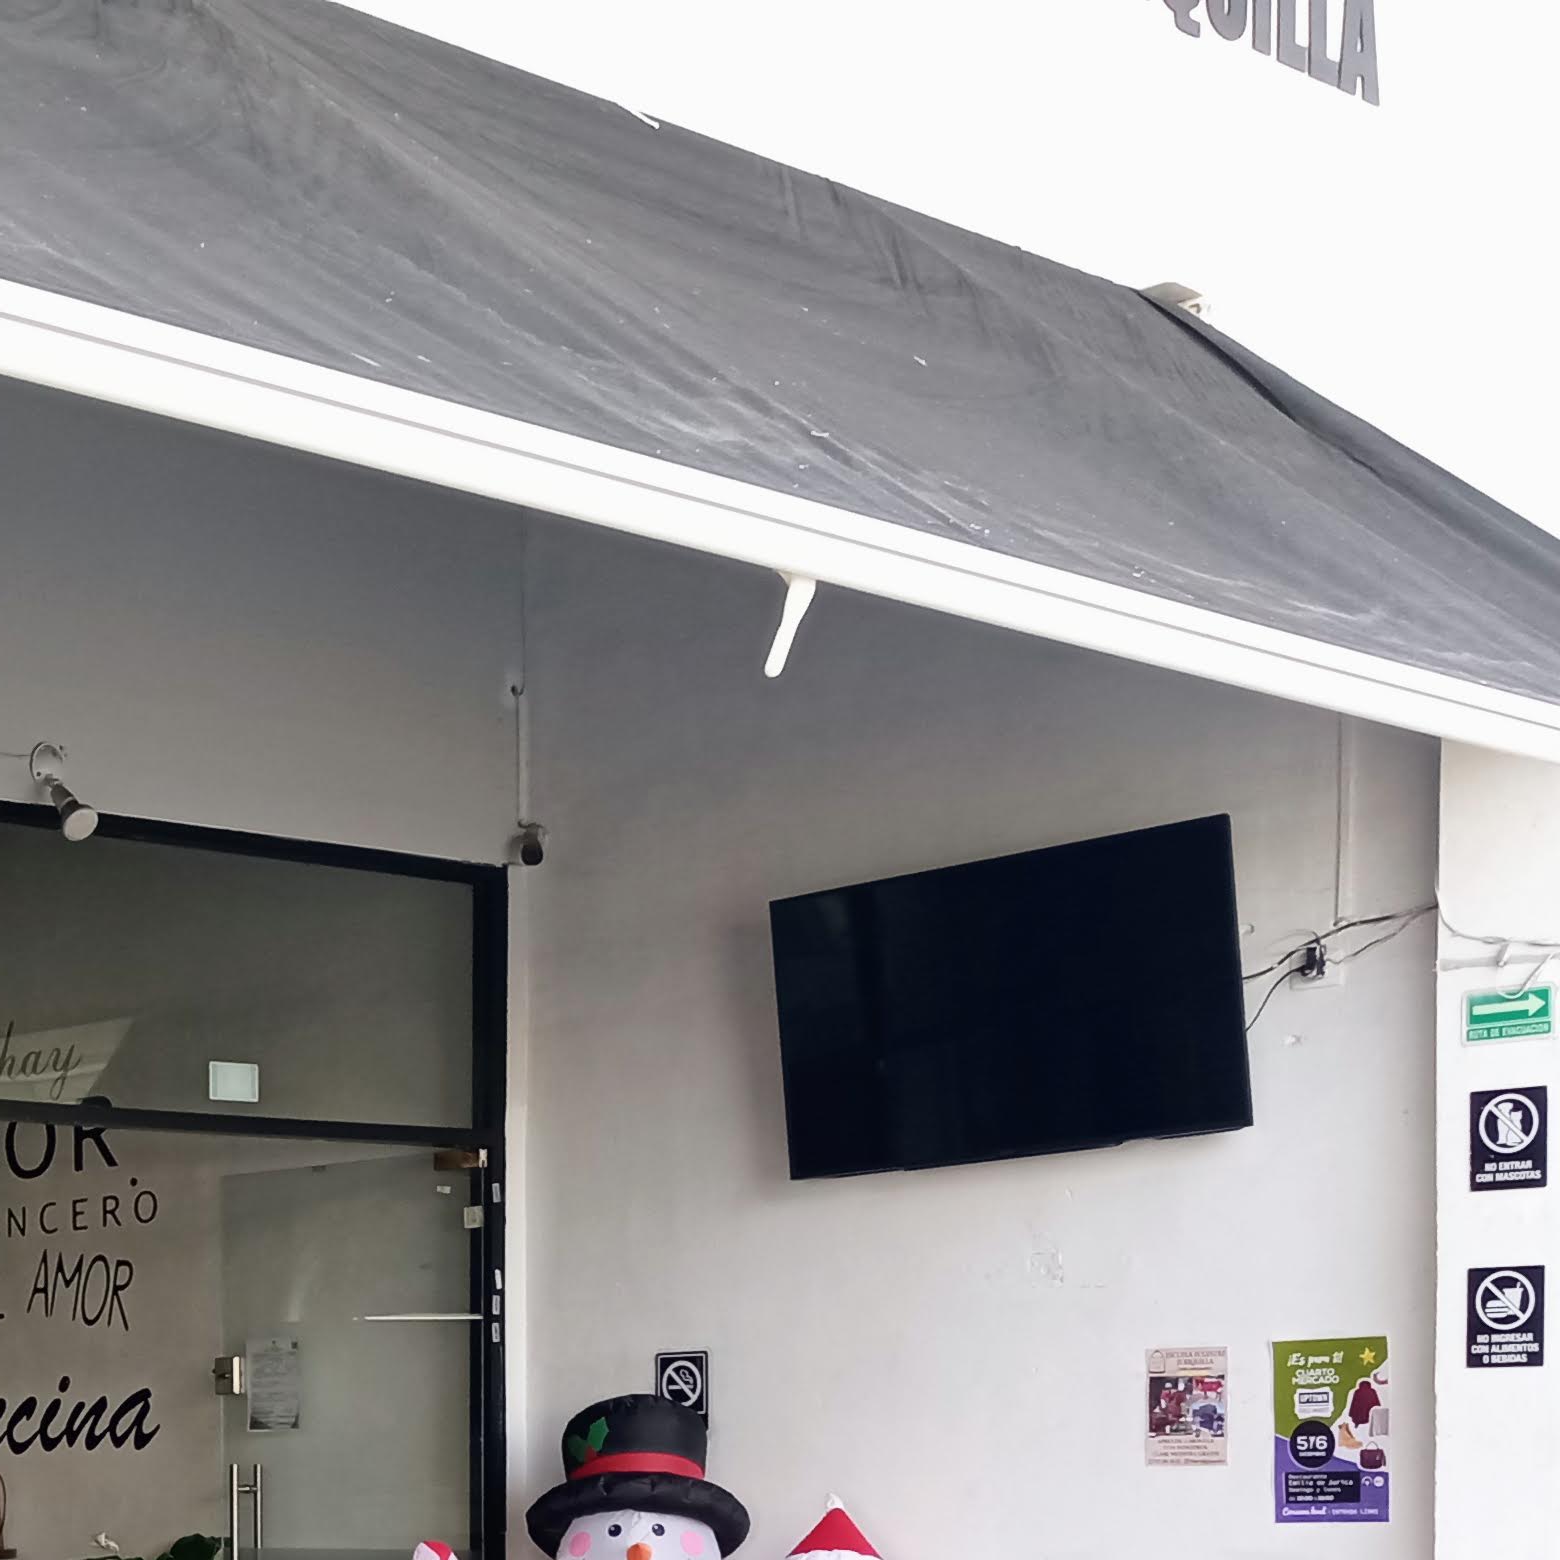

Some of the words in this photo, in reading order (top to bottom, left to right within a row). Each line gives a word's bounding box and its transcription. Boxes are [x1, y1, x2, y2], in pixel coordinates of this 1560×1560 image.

[1484, 1163, 1497, 1172] NO
[1498, 1160, 1533, 1171] ENTRAR
[1476, 1174, 1494, 1183] CON
[1495, 1170, 1542, 1182] MASCOTAS
[26, 1248, 134, 1332] AMOR
[1476, 1334, 1490, 1343] NO
[1490, 1332, 1534, 1343] INGRESAR
[1471, 1344, 1490, 1354] CON
[1490, 1342, 1540, 1353] ALIMENTOS
[1490, 1353, 1528, 1364] BEBIDAS
[1295, 1368, 1335, 1377] CUARTO
[1292, 1375, 1340, 1385] MERCADO
